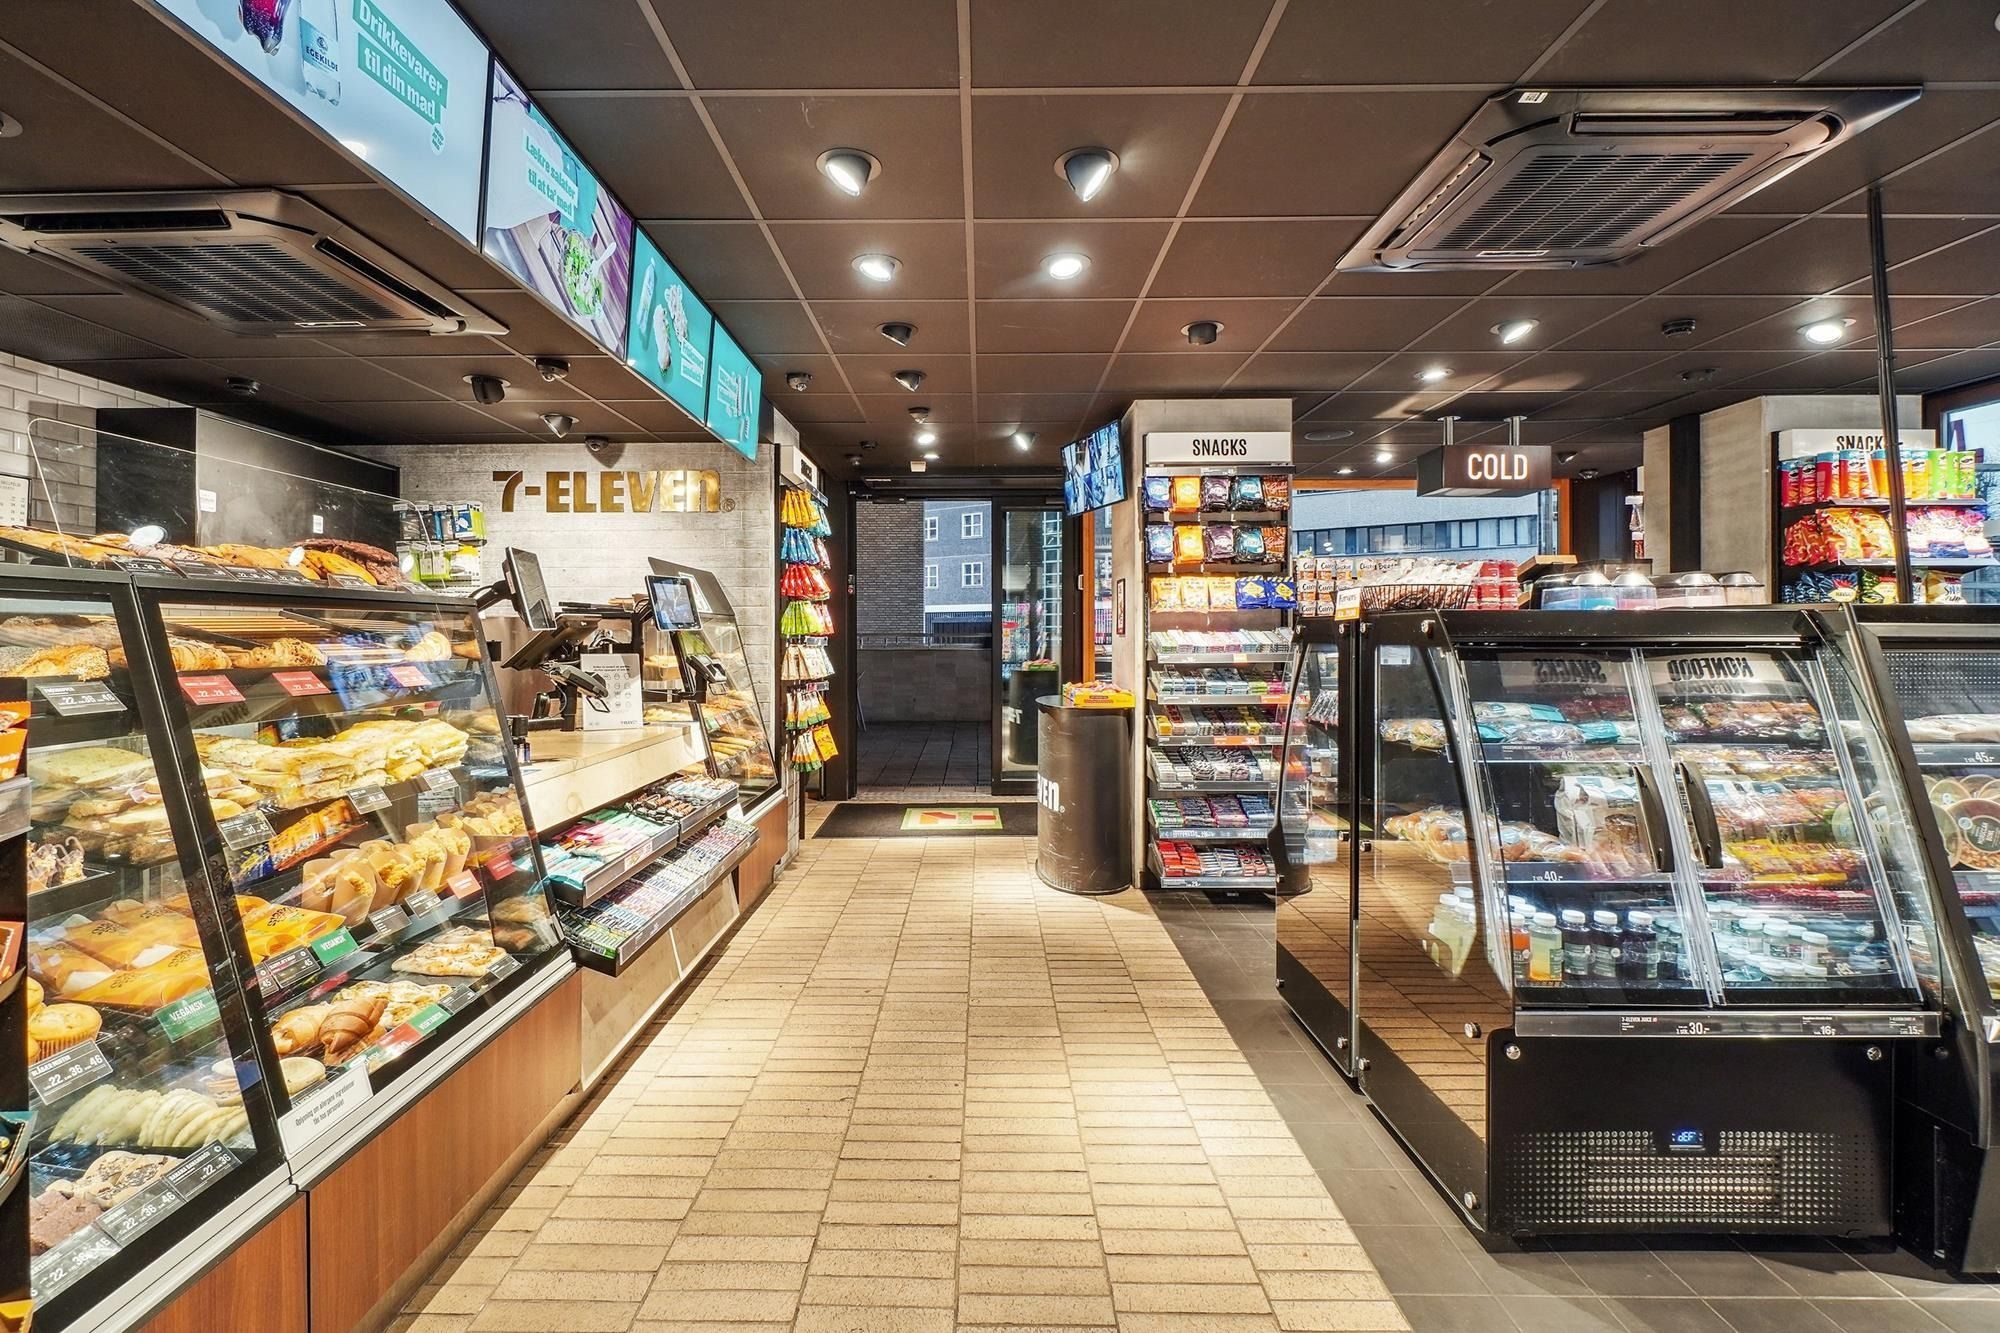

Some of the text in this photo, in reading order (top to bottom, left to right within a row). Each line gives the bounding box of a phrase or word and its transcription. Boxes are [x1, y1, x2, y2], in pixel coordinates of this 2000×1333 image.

[306, 46, 338, 72] EGEKILDE
[359, 3, 443, 96] Drikkevarer
[364, 48, 436, 119] til din mad
[526, 136, 576, 199] Lækre salater
[528, 168, 537, 187] til
[537, 179, 546, 195] at
[556, 195, 572, 217] med
[1192, 438, 1248, 457] SNACKS
[1836, 435, 1884, 452] SNACK
[1468, 453, 1528, 480] COLD
[169, 999, 206, 1021] VEGANSK
[68, 1064, 83, 1077] 36
[89, 1054, 103, 1066] 46
[203, 1153, 232, 1176] 22 36
[161, 1191, 176, 1203] 46
